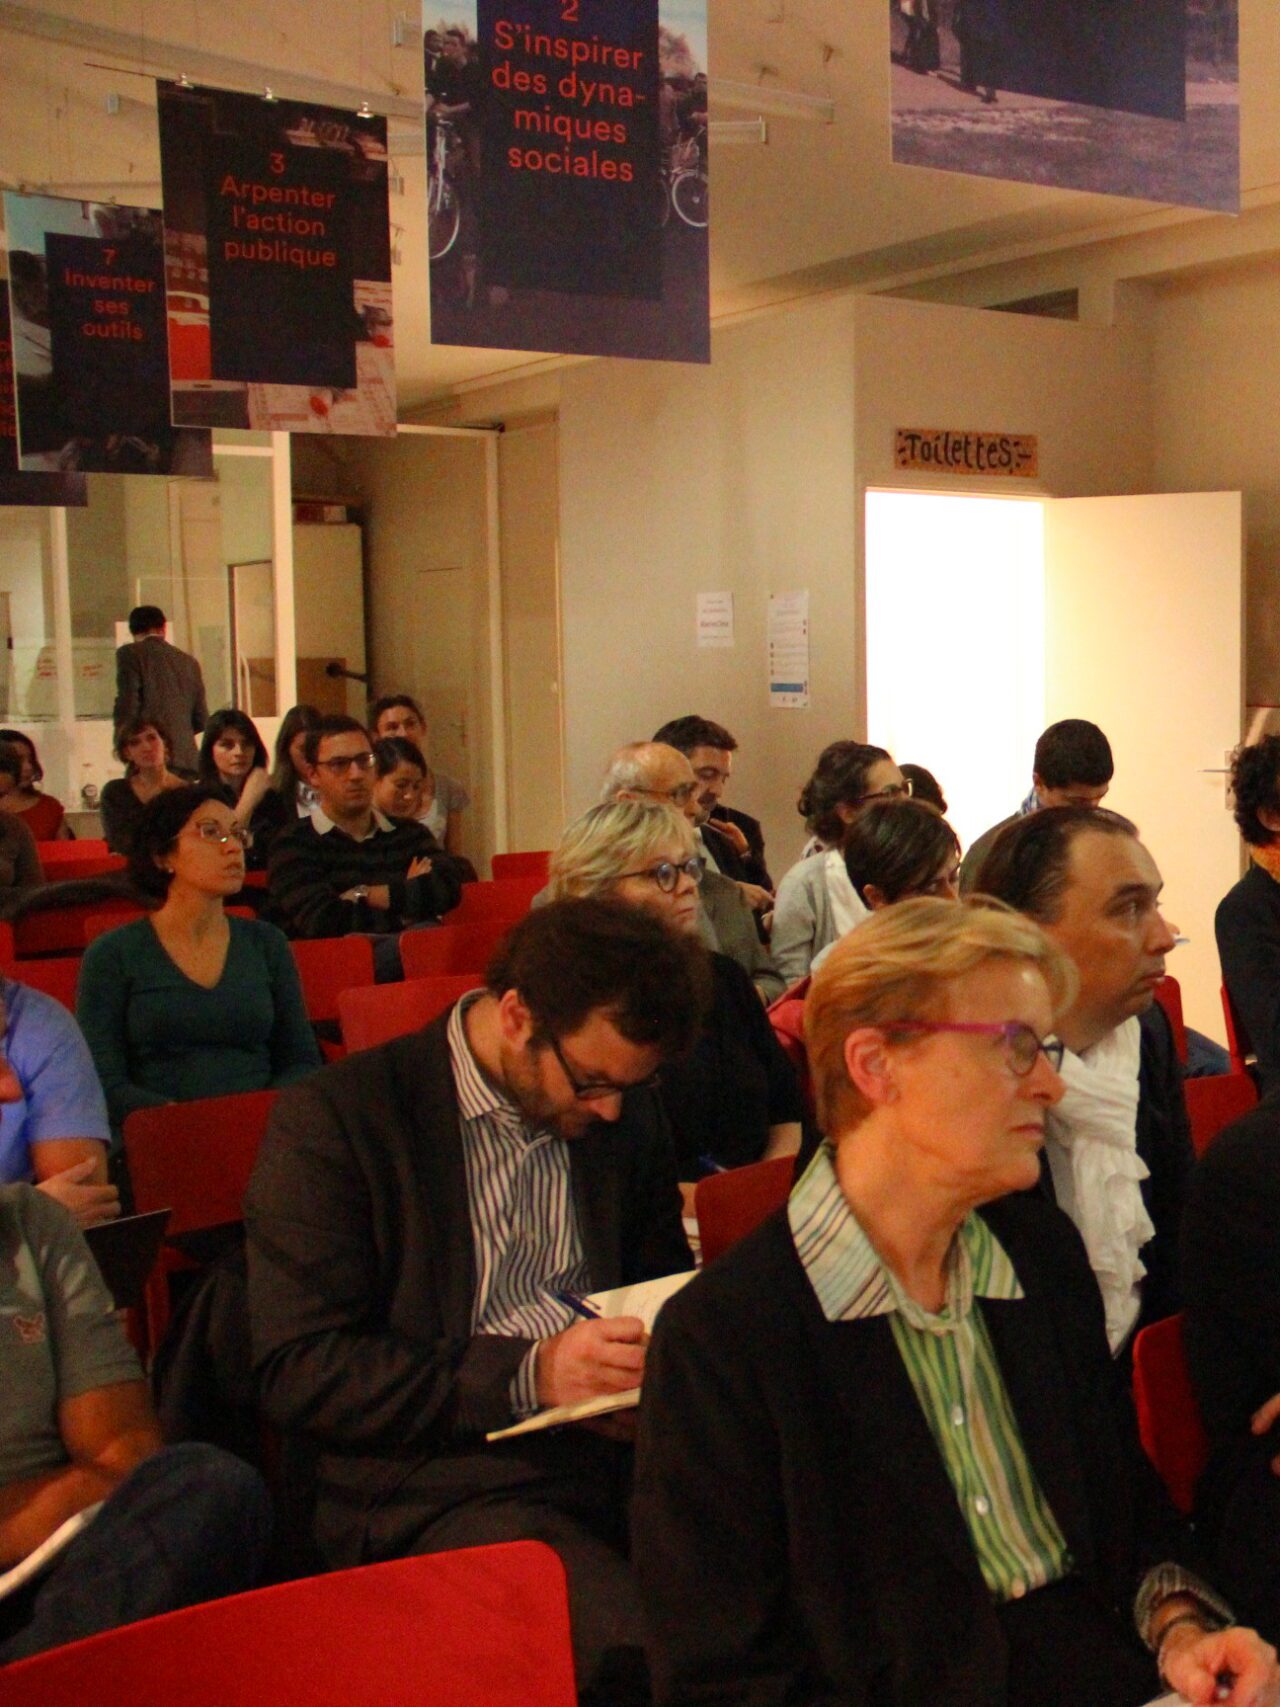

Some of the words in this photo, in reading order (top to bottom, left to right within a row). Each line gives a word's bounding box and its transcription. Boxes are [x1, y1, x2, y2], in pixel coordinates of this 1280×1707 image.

[560, 0, 579, 22] 2
[491, 60, 547, 94] des
[558, 71, 646, 107] dyna-
[513, 104, 627, 144] miques
[270, 152, 285, 174] 3
[507, 147, 634, 182] sociales
[220, 175, 336, 209] Arpenter
[232, 205, 326, 237] l'action
[102, 248, 116, 266] 7
[224, 239, 336, 269] publique
[64, 269, 156, 293] Inventer
[94, 300, 129, 315] ses
[83, 321, 143, 340] outils
